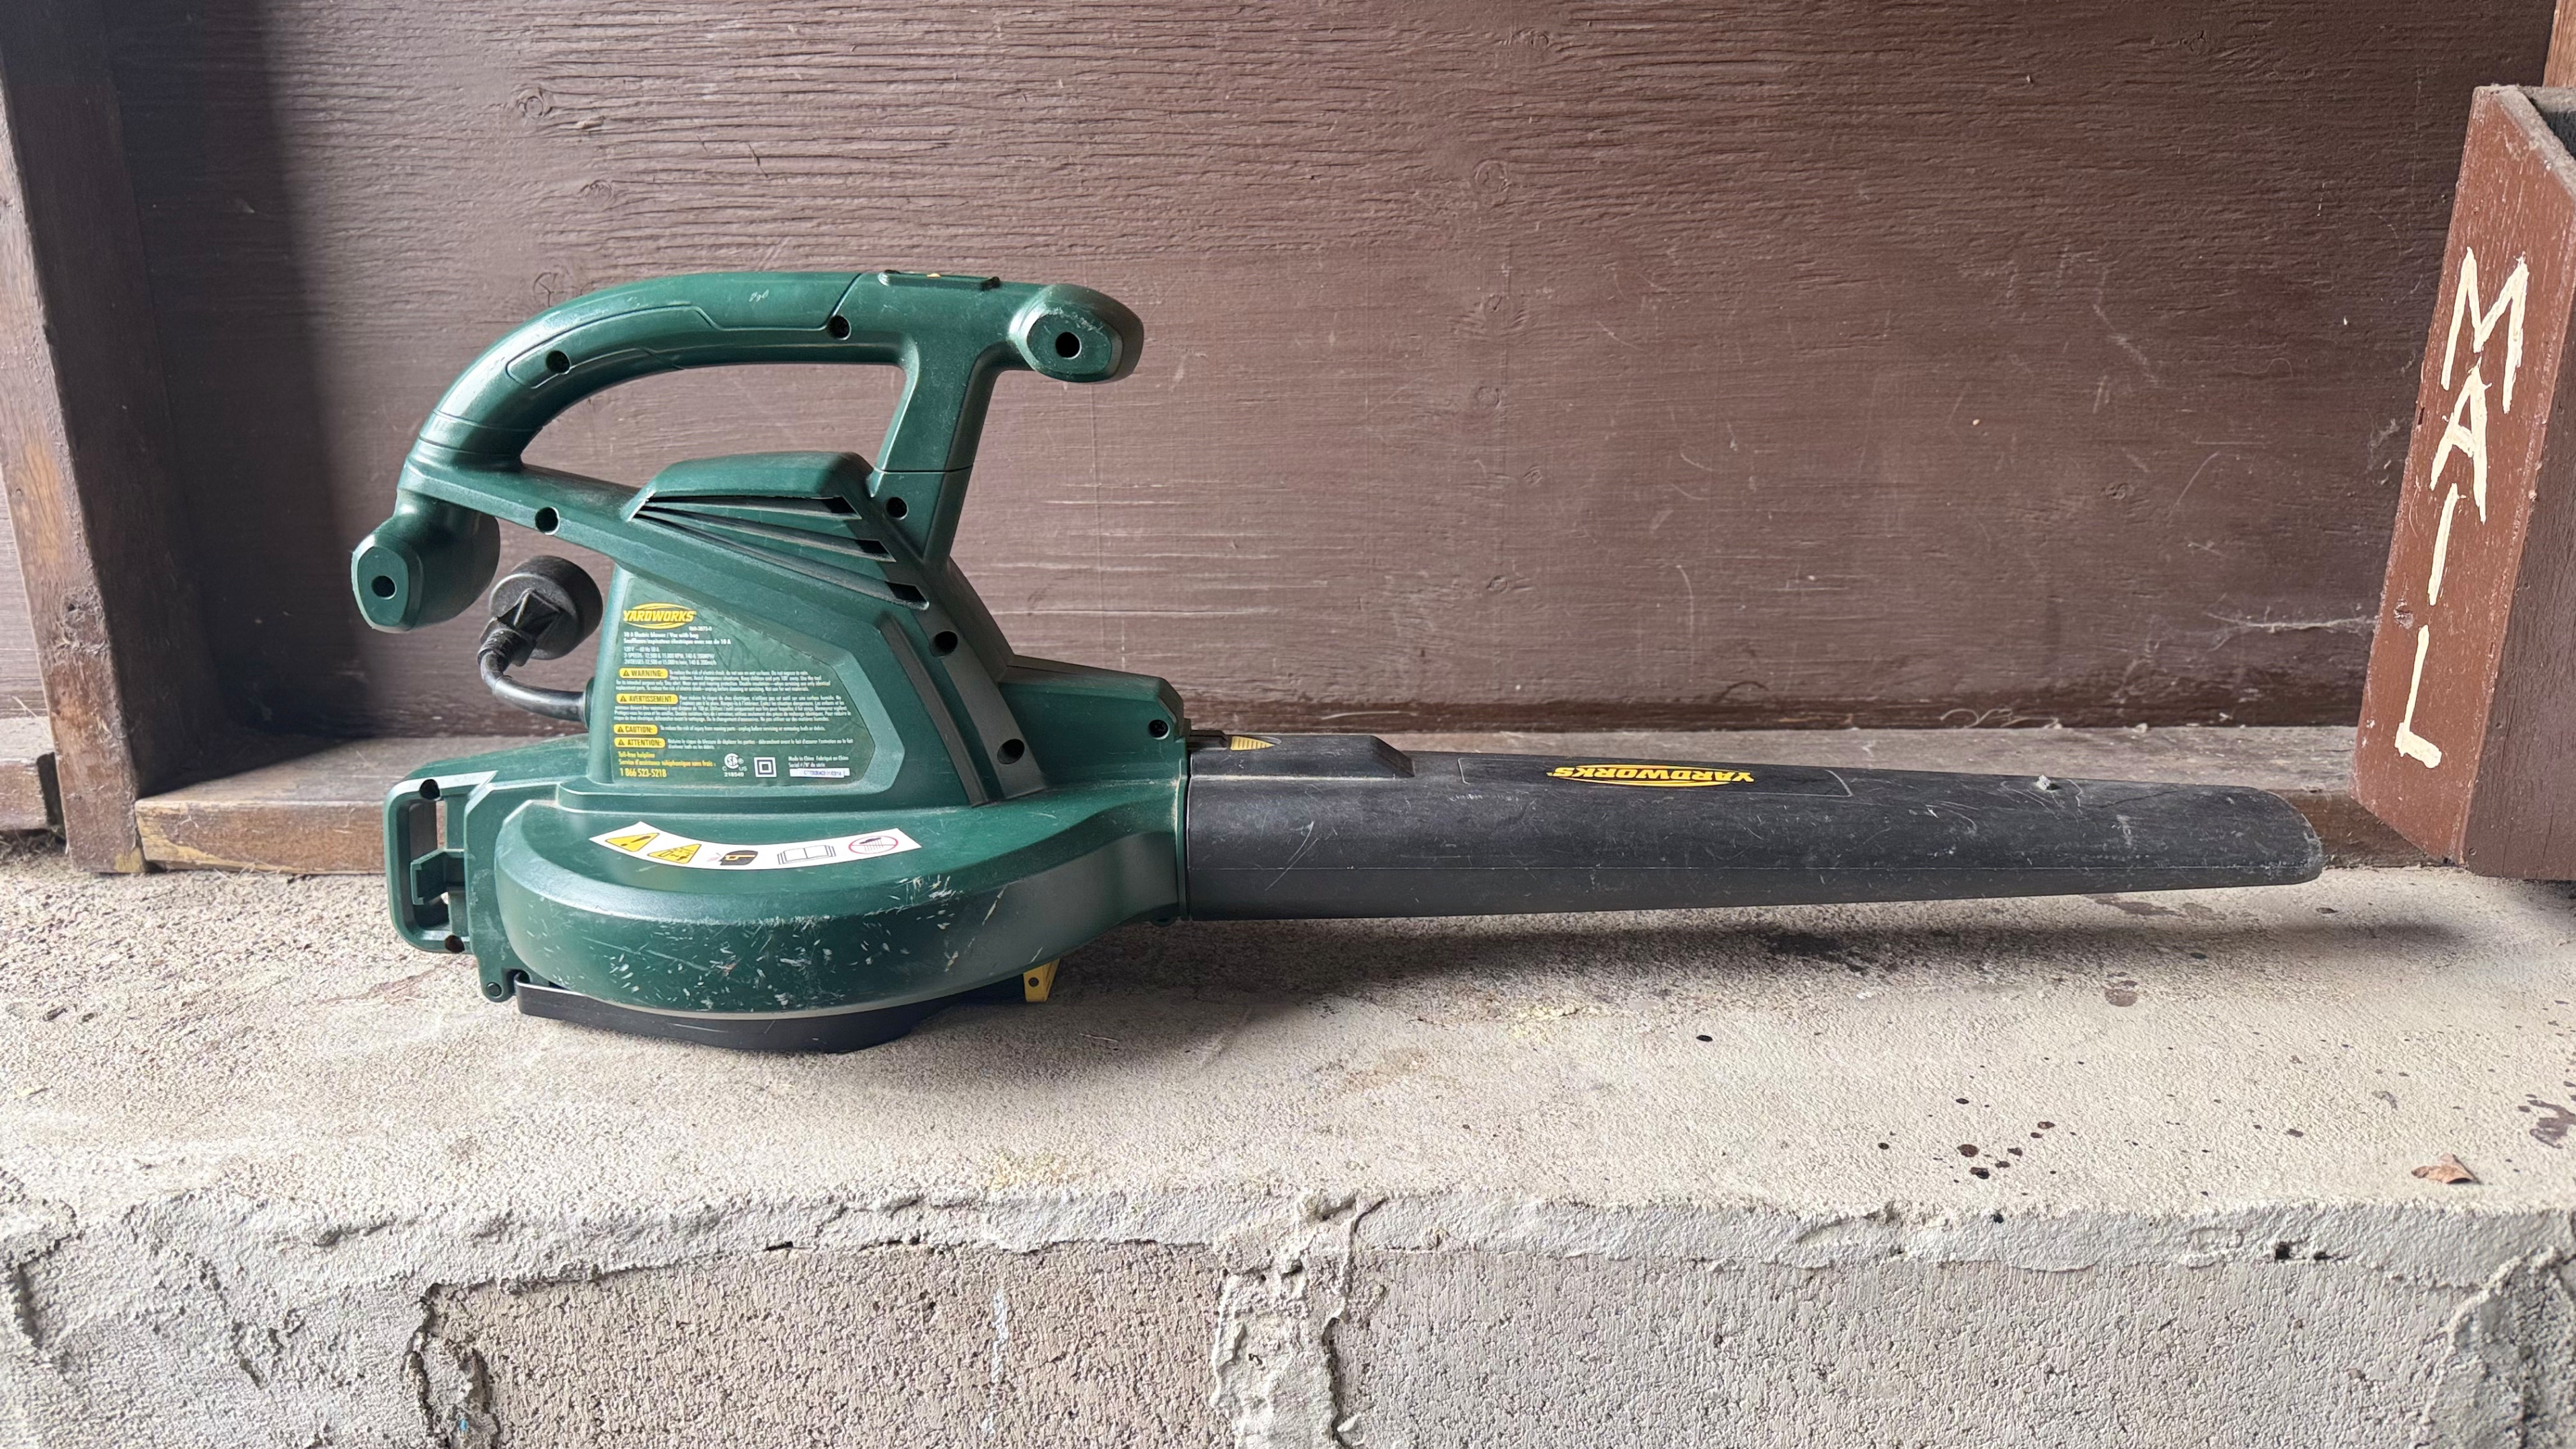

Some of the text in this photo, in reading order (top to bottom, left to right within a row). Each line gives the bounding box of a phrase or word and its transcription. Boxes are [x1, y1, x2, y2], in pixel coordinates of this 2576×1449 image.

[2395, 246, 2529, 769] MAIL
[623, 610, 695, 622] YARDWORKS
[619, 768, 667, 778] 1 866 523-5218
[1552, 766, 1755, 783] YARDWORKS
